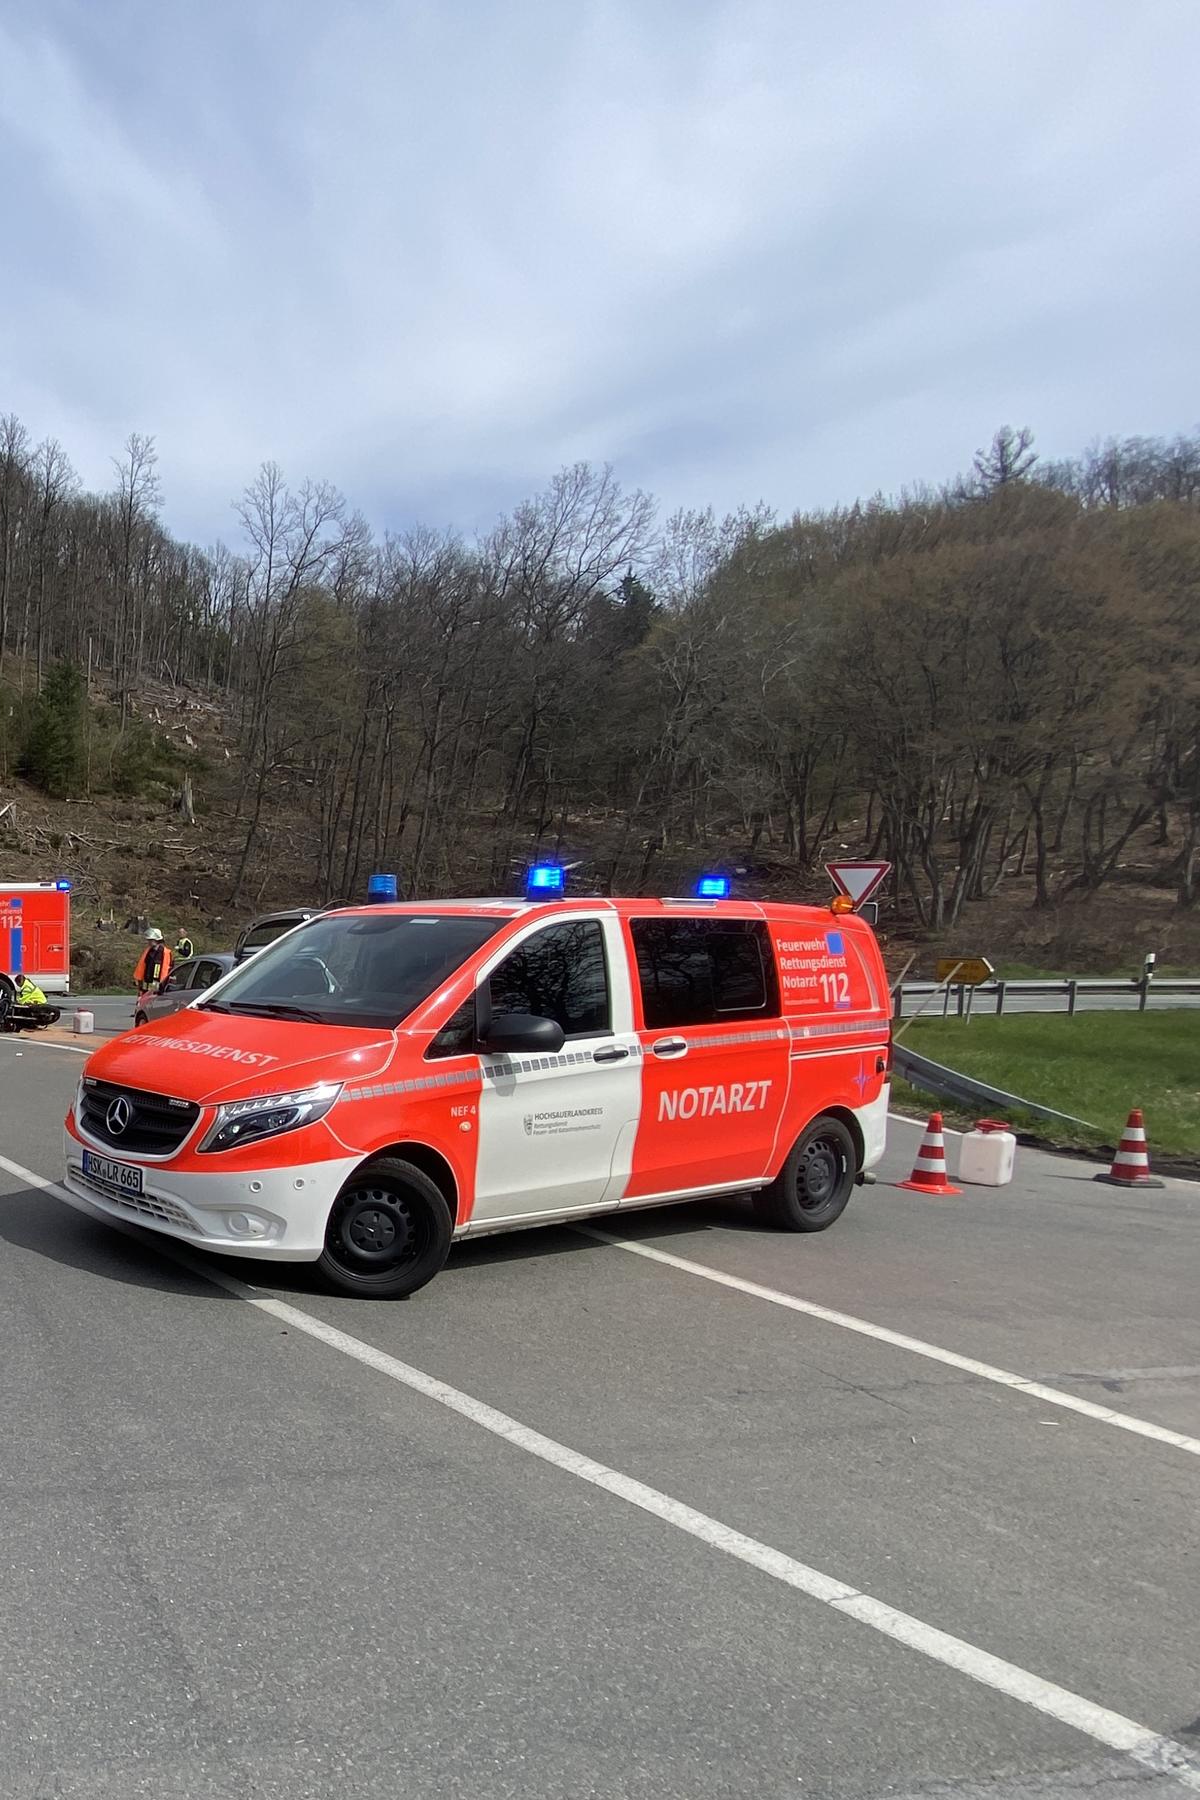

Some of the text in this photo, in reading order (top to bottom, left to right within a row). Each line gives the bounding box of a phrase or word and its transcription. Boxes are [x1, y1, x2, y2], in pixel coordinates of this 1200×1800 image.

[1, 915, 23, 929] 112
[776, 938, 827, 952] Feuerwehr
[780, 956, 847, 972] Rettungsdienst
[782, 975, 818, 988] Notarzt
[820, 972, 851, 1003] 112
[658, 1080, 773, 1122] NOTARZT
[451, 1105, 477, 1117] NEF 4
[534, 1107, 603, 1120] HOCHSAUERLANDKREIS
[89, 1155, 139, 1188] HSK LR 665
